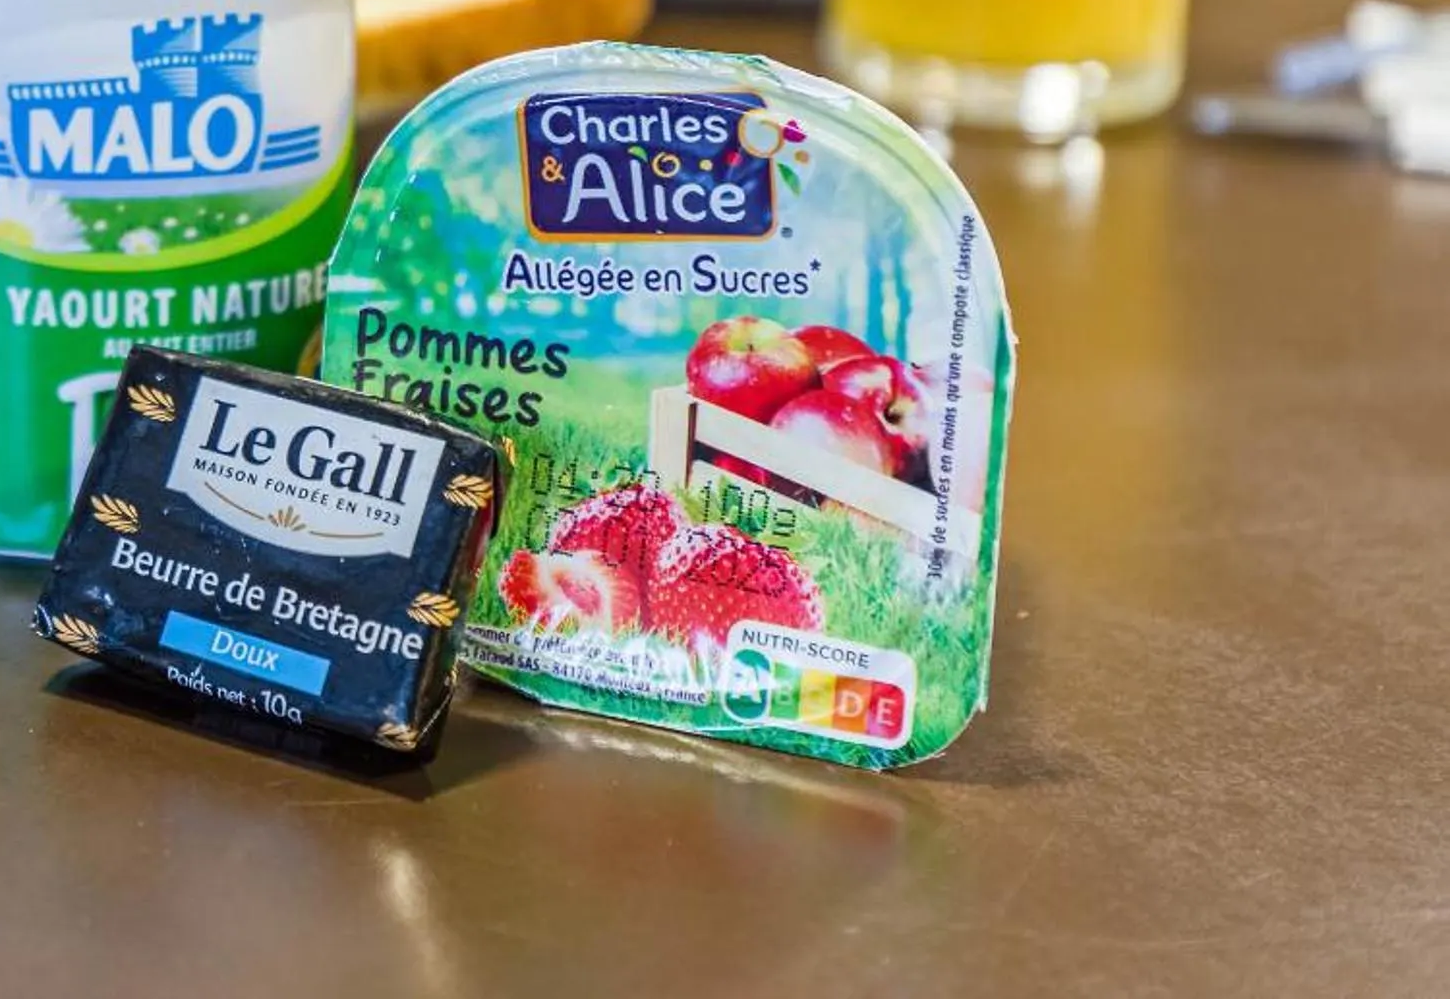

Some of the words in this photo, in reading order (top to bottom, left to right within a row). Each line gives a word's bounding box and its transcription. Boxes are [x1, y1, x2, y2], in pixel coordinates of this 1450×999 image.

[27, 94, 256, 173] MALO
[540, 105, 729, 146] Charles
[541, 157, 565, 182] &
[562, 150, 748, 224] Alice
[953, 214, 977, 280] classique
[7, 286, 178, 328] YAOURT
[192, 264, 327, 324] NATURE
[504, 254, 634, 296] Allégée
[644, 266, 682, 292] en
[188, 328, 257, 354] ENTIER
[948, 284, 971, 348] compote
[356, 308, 570, 377] Pommes
[354, 358, 544, 426] Fraises
[943, 352, 964, 402] qu'une
[199, 398, 279, 466] Le
[285, 424, 418, 506] Gall
[939, 405, 958, 449] moins
[938, 454, 953, 471] en
[193, 458, 258, 485] MAISON
[265, 477, 330, 506] FONDÉE
[336, 498, 356, 515] EN
[366, 506, 401, 526] 1923
[930, 526, 947, 544] de
[111, 538, 219, 596] Beurre
[225, 576, 267, 611] de
[272, 587, 424, 660] Bretagne
[210, 630, 280, 672] Doux
[741, 628, 870, 670] NUTRI-SCORE
[167, 662, 212, 697] Poids
[217, 684, 247, 706] net
[838, 690, 864, 718] D
[876, 696, 897, 727] E
